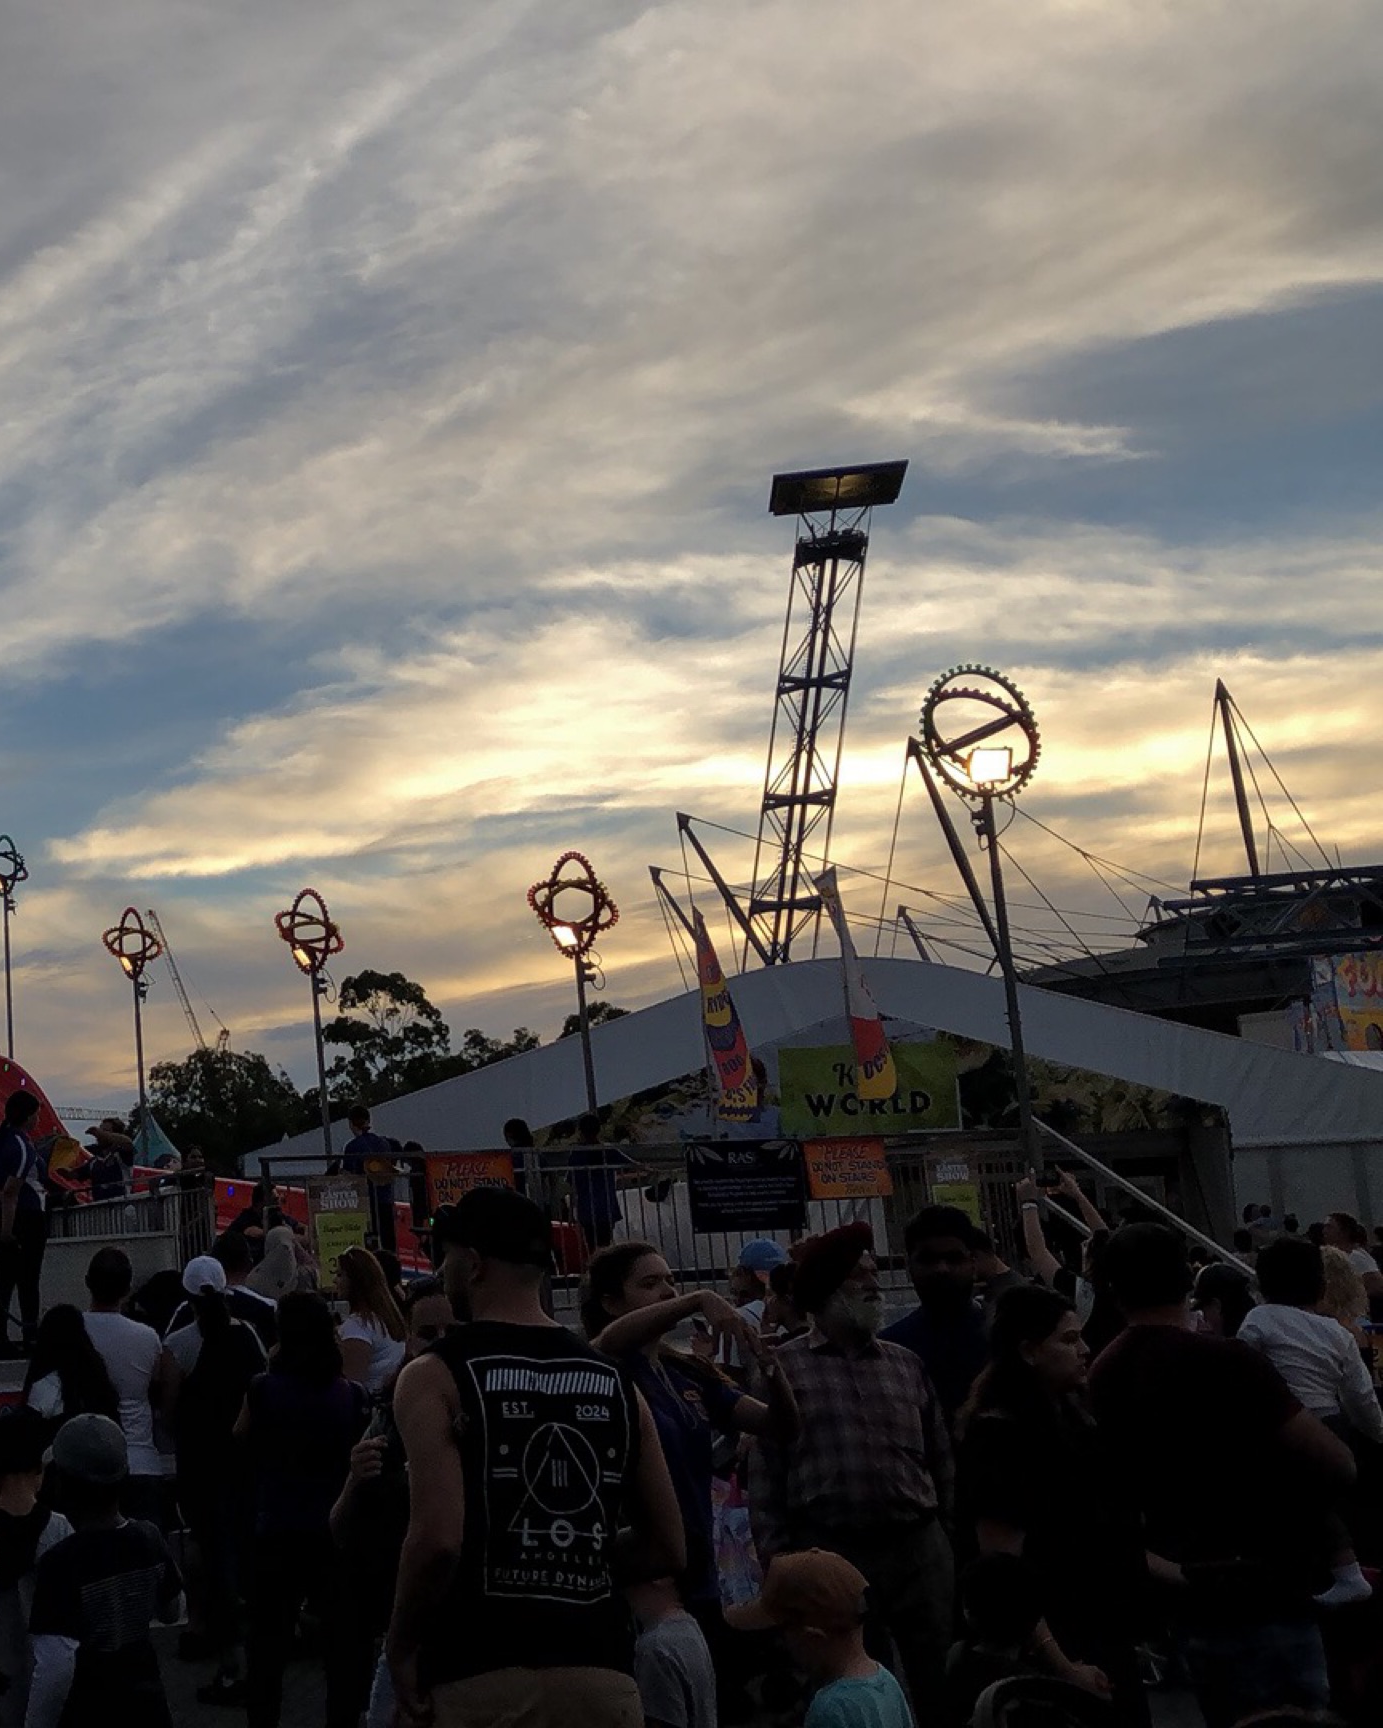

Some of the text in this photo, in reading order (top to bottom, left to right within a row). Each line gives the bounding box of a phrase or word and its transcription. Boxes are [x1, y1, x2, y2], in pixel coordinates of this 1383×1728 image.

[804, 1091, 932, 1118] WORLD
[825, 1145, 867, 1160] PLEASE
[849, 1159, 885, 1170] STAND
[450, 1176, 470, 1188] NOT
[474, 1176, 508, 1187] STAND
[838, 1172, 878, 1183] STAIRS
[320, 1190, 358, 1201] EASTER
[438, 1191, 454, 1202] ON
[320, 1198, 359, 1210] SHOW
[502, 1401, 610, 1418] EST. 2024
[521, 1518, 604, 1551] LOS
[494, 1567, 548, 1582] FUTURE
